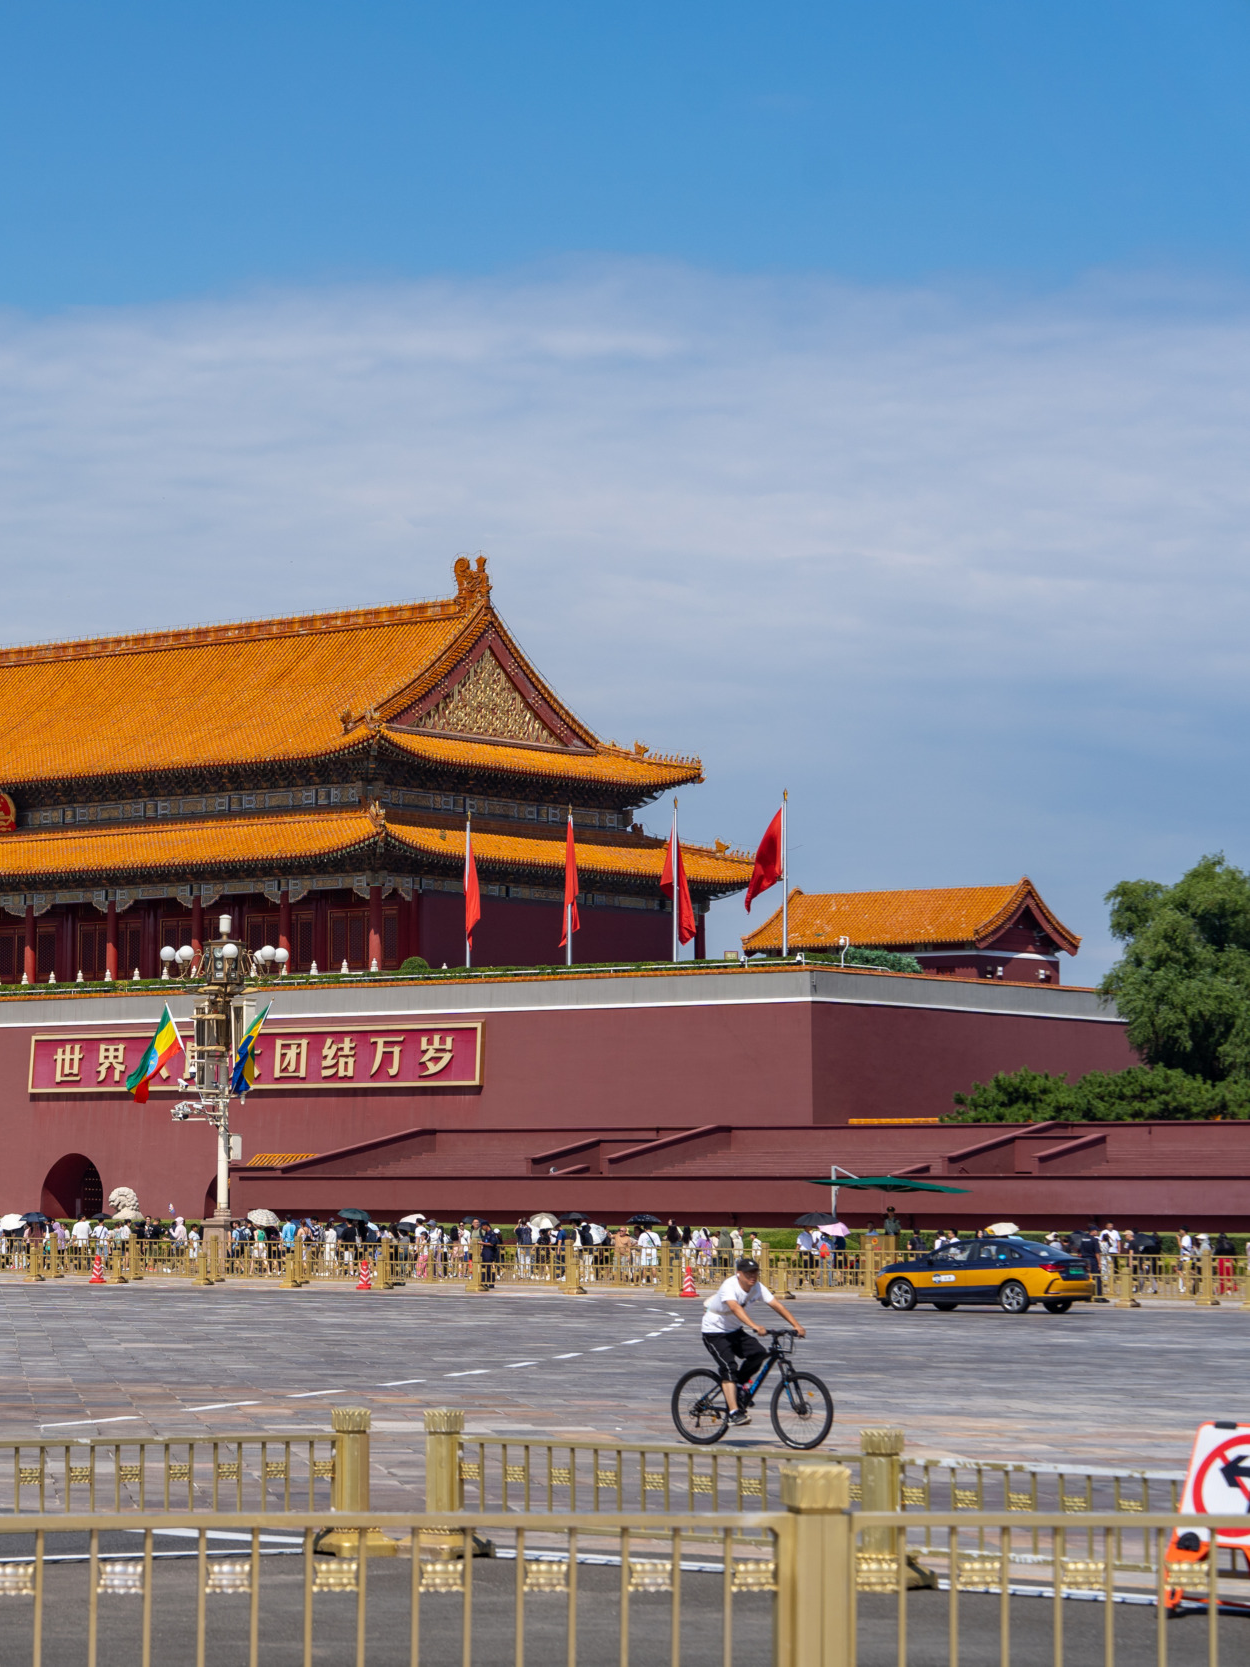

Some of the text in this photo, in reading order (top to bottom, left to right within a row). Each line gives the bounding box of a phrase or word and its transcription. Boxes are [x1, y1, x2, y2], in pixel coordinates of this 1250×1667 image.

[53, 1034, 454, 1084] 世界团结万岁
